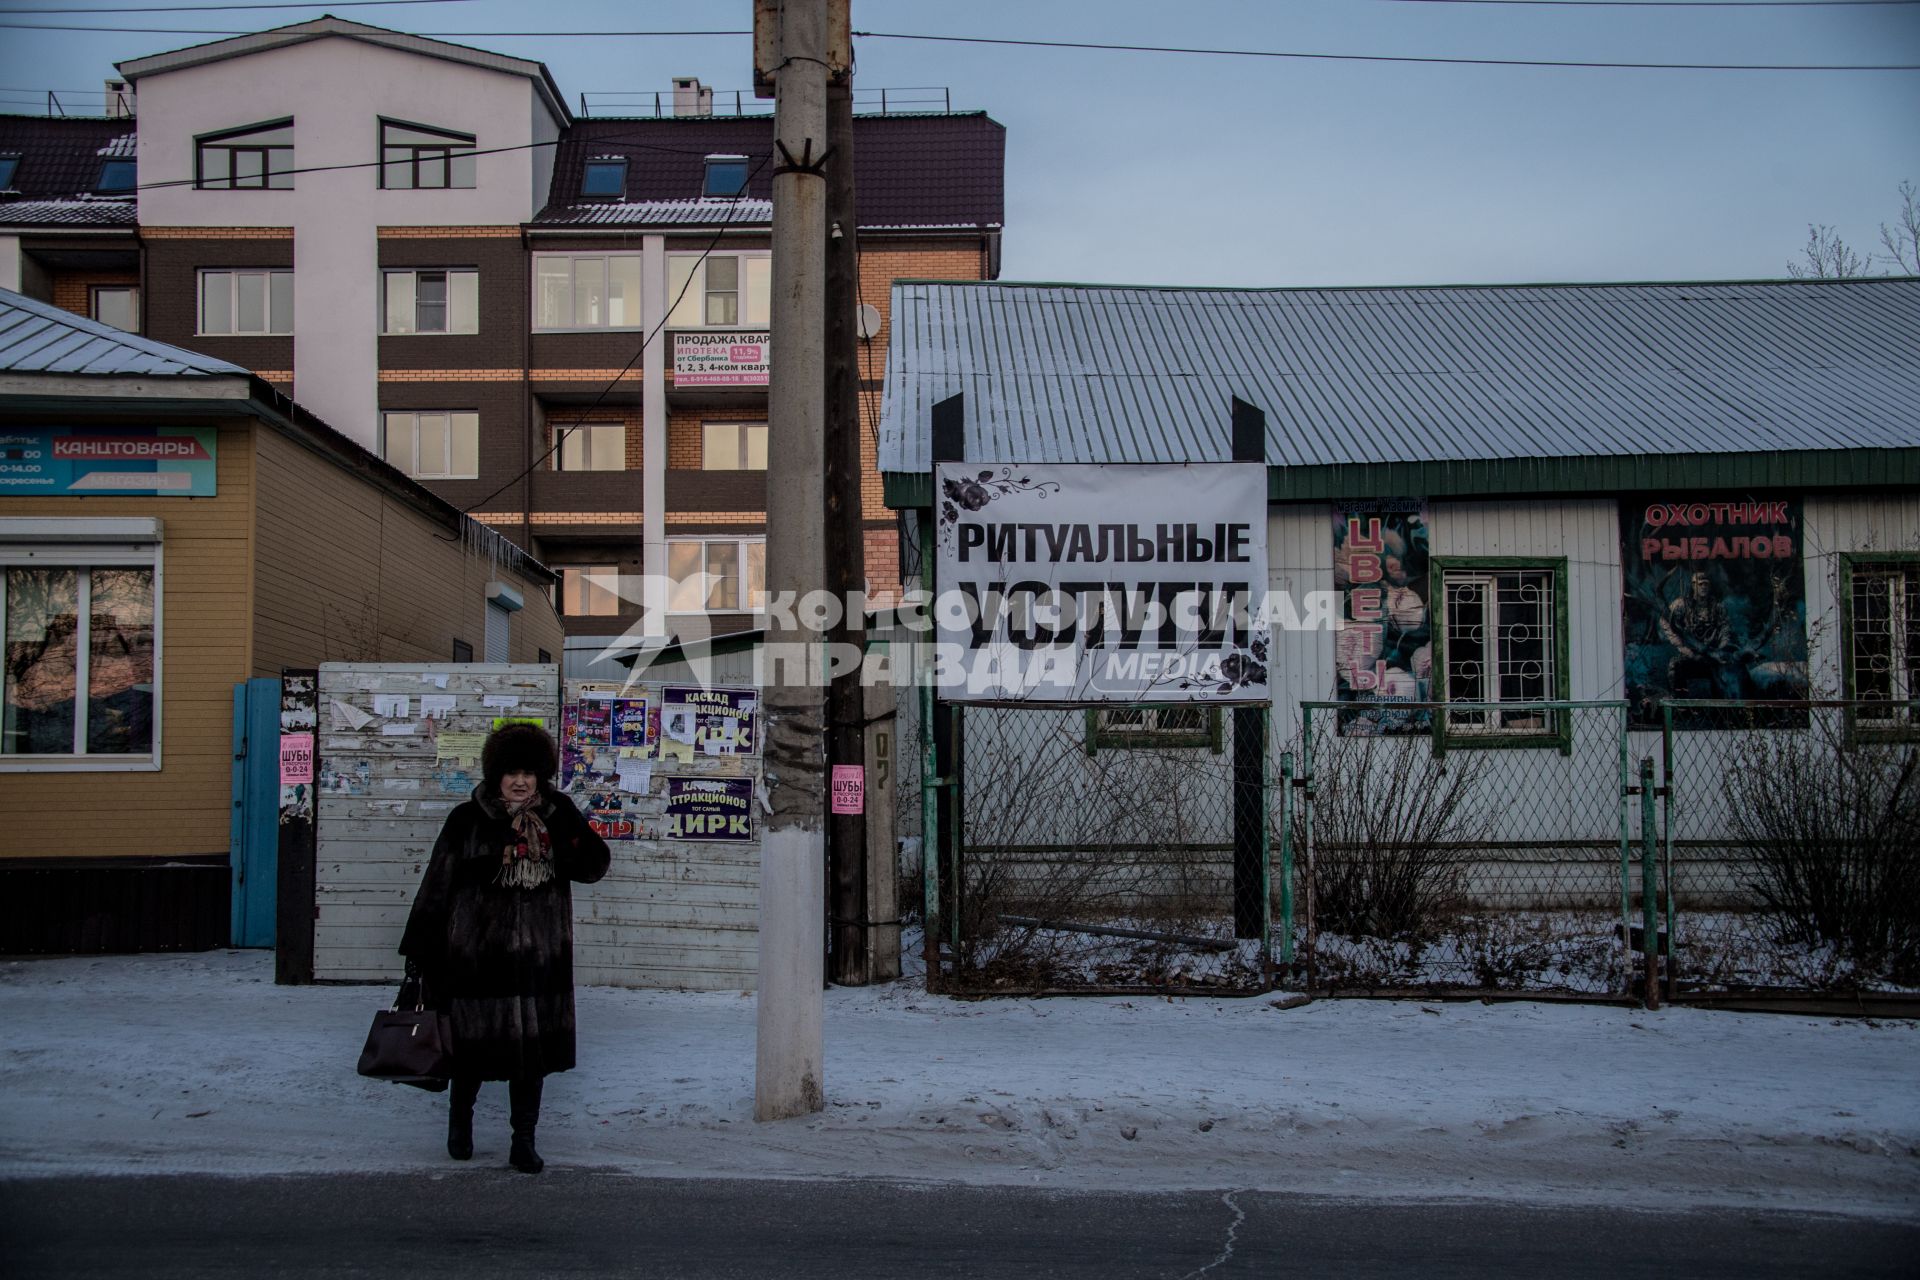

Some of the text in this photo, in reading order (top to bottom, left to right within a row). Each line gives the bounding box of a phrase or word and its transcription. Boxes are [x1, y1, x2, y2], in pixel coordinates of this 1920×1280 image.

[677, 335, 737, 345] ПРОДАЖА
[677, 347, 727, 355] ИПОТЕКА
[687, 355, 728, 363] Сбербанка
[677, 364, 685, 373] 1,
[688, 364, 696, 373] 2,
[698, 364, 706, 373] 3,
[54, 440, 195, 456] КАНЦТОВАРЫ
[90, 474, 168, 487] МАГАЗИН
[1337, 502, 1377, 513] магазин
[1645, 500, 1788, 527] ОХОТНИК
[958, 523, 1251, 563] РИТУАЛЬНЫЕ
[1641, 534, 1793, 561] РЫБАЛОВ
[1348, 517, 1388, 690] ЦВЕТЫ
[958, 581, 1250, 651] УСЛУГИ
[685, 692, 729, 706] КАСКАД
[282, 749, 312, 762] ШУБЫ
[833, 780, 862, 792] ШУБЫ
[836, 796, 859, 804] 0-0-24
